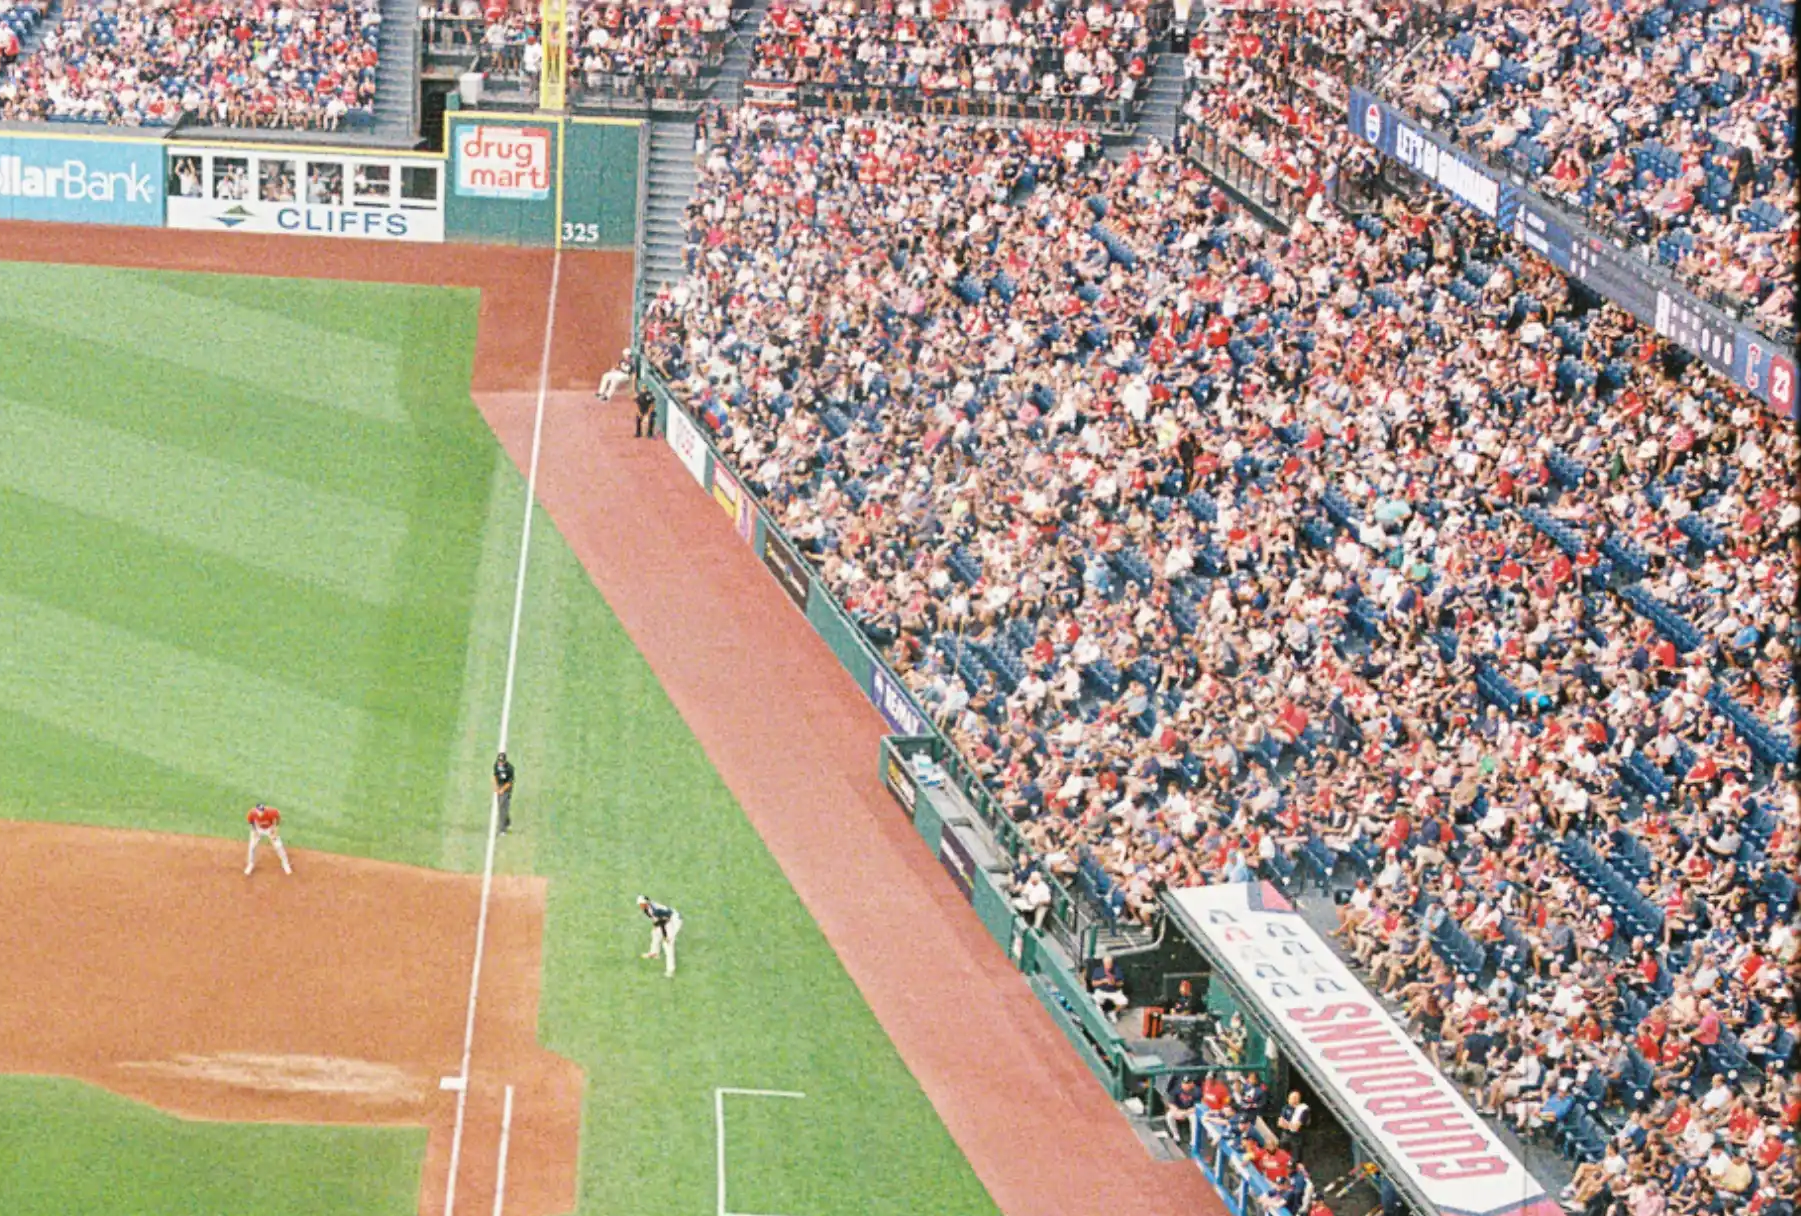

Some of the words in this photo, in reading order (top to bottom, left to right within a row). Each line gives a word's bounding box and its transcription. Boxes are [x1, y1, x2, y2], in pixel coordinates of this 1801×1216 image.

[464, 125, 533, 168] drug
[470, 167, 547, 189] mart
[277, 207, 409, 237] CLIFFS
[562, 222, 600, 242] 325
[1285, 1001, 1509, 1180] GUARDIANS
